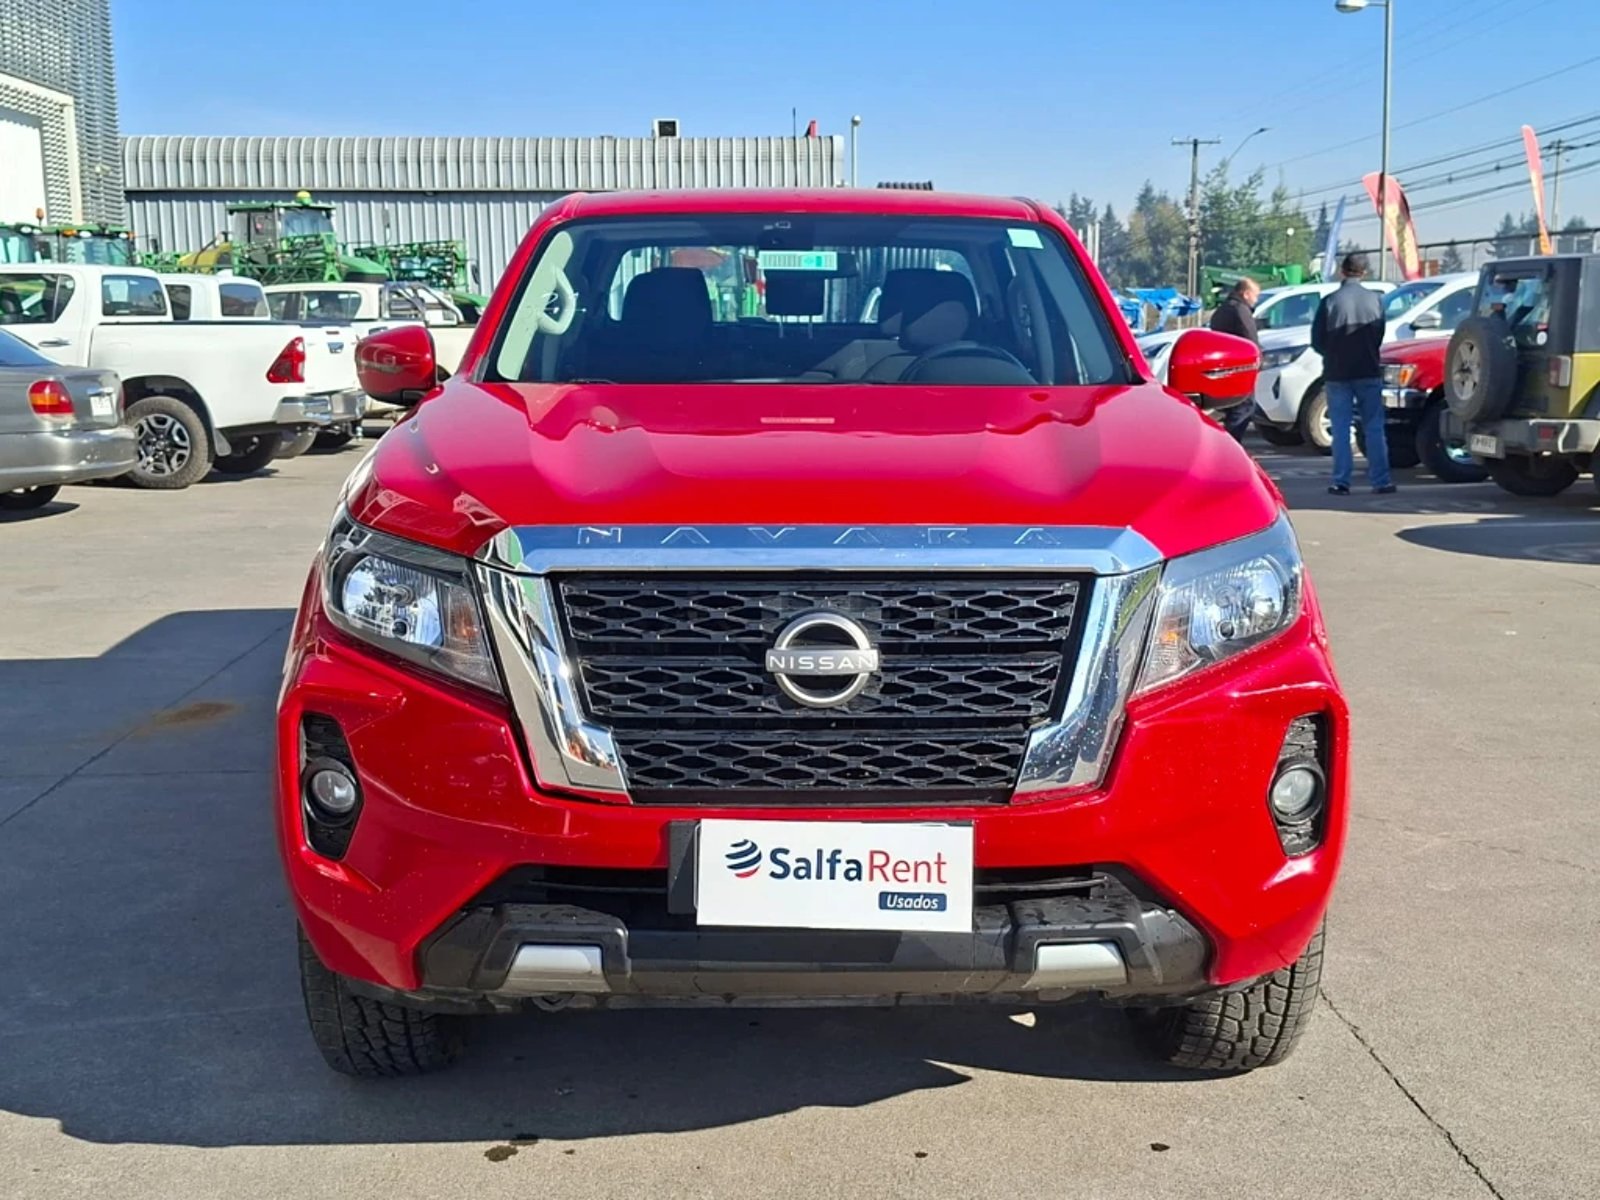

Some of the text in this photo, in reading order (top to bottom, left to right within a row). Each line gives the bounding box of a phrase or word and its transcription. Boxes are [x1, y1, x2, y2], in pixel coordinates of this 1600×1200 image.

[577, 526, 1062, 545] NAVARA
[769, 655, 875, 670] NISSAN
[769, 847, 948, 885] SalfaRent
[886, 893, 940, 910] Usados
